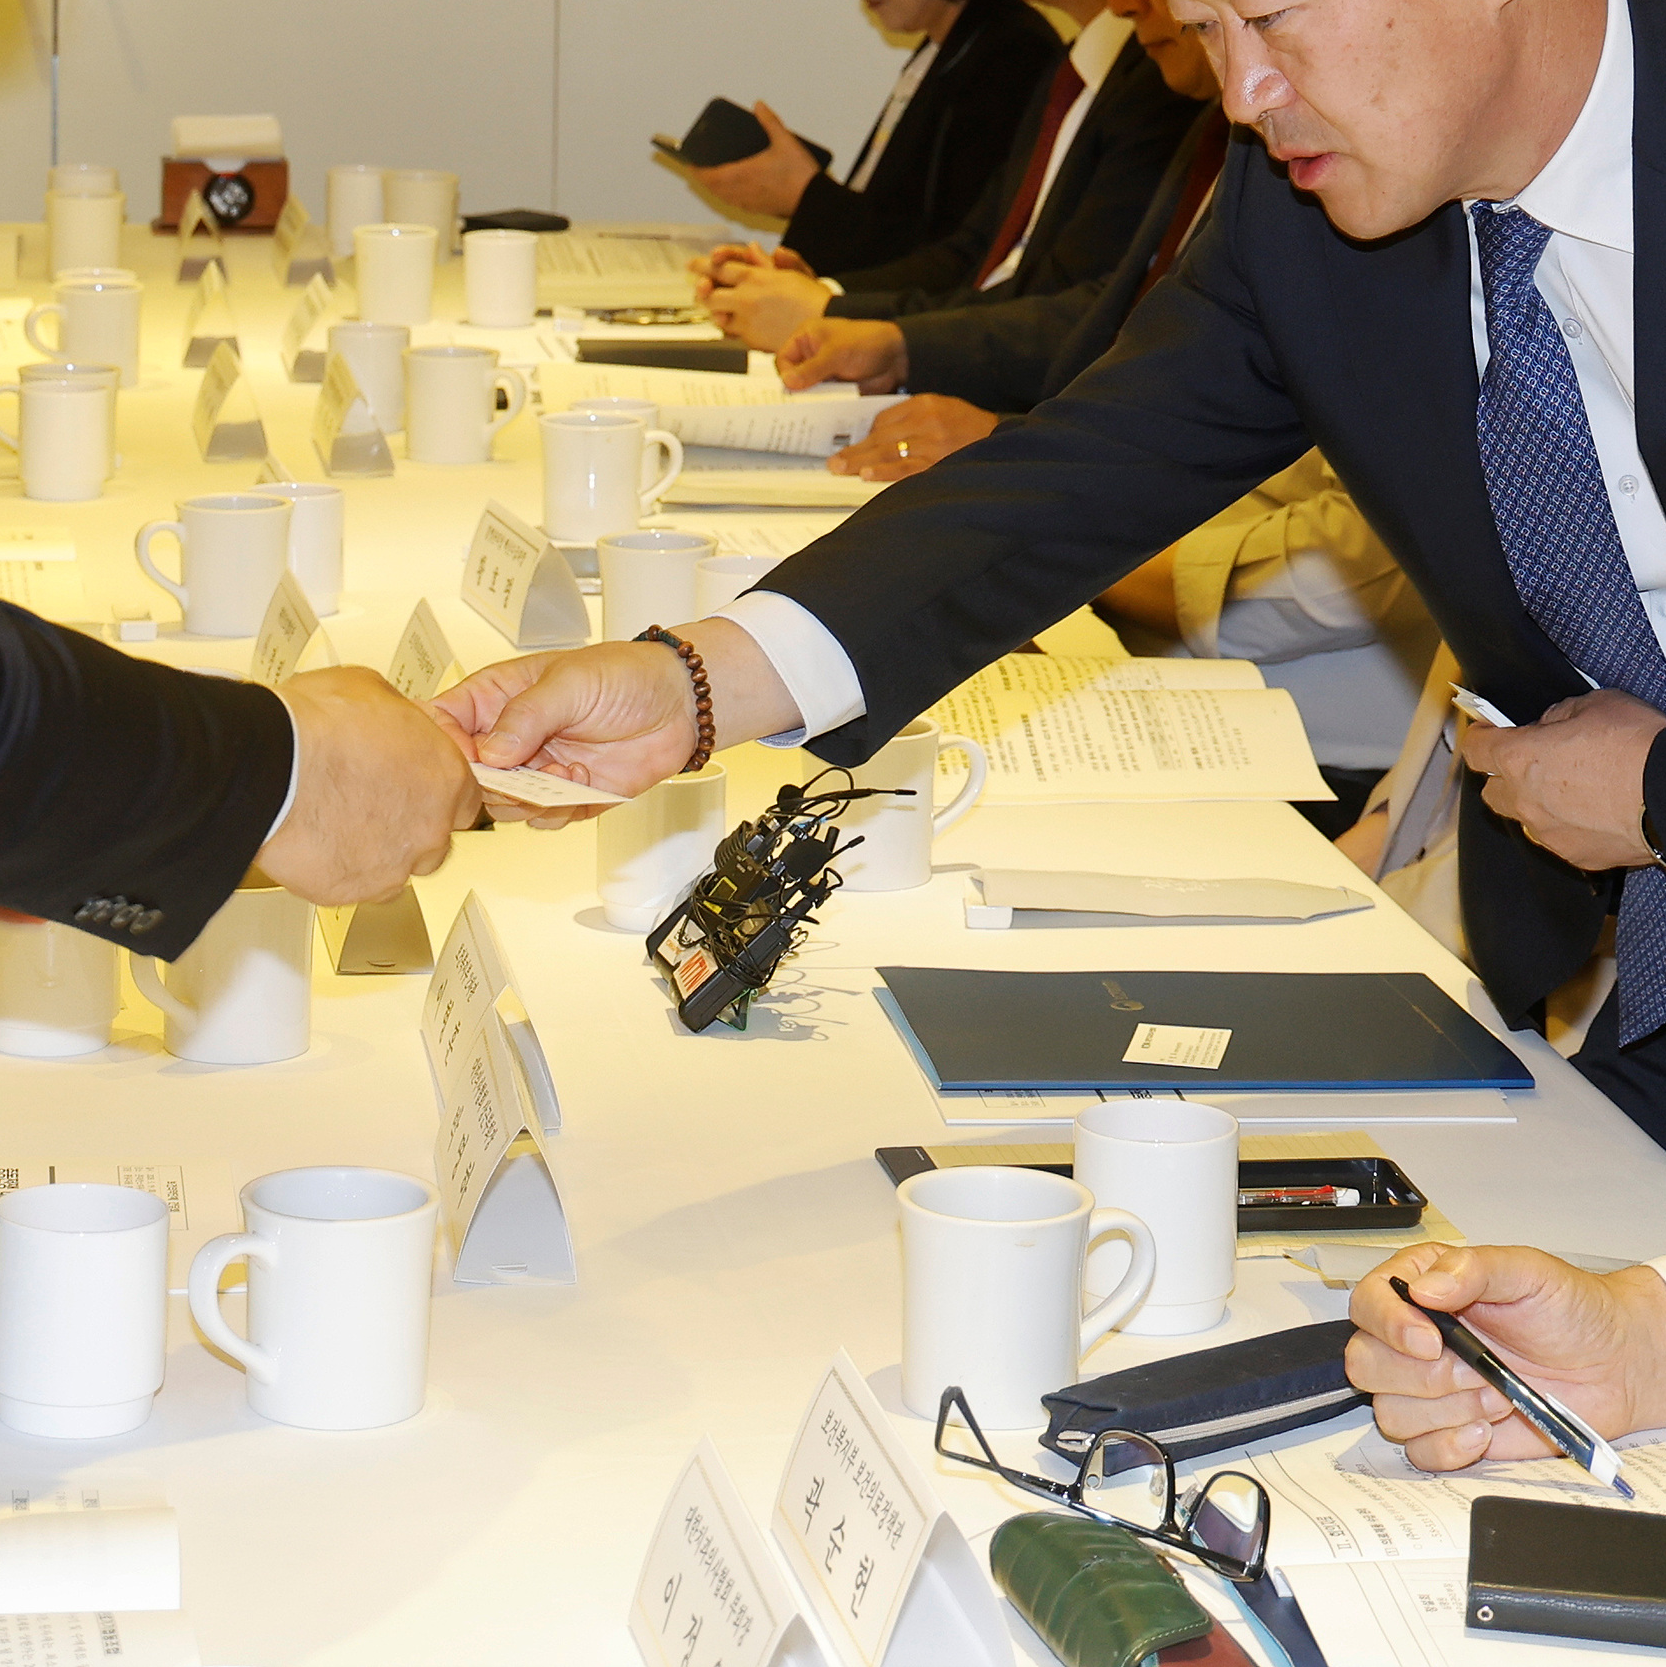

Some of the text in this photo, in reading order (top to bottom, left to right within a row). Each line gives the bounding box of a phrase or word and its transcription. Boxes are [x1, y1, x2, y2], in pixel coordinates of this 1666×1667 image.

[821, 1409, 905, 1550] 보건복지부 보건의료정책관
[684, 1506, 753, 1647] 대한치과의사협회 부회장
